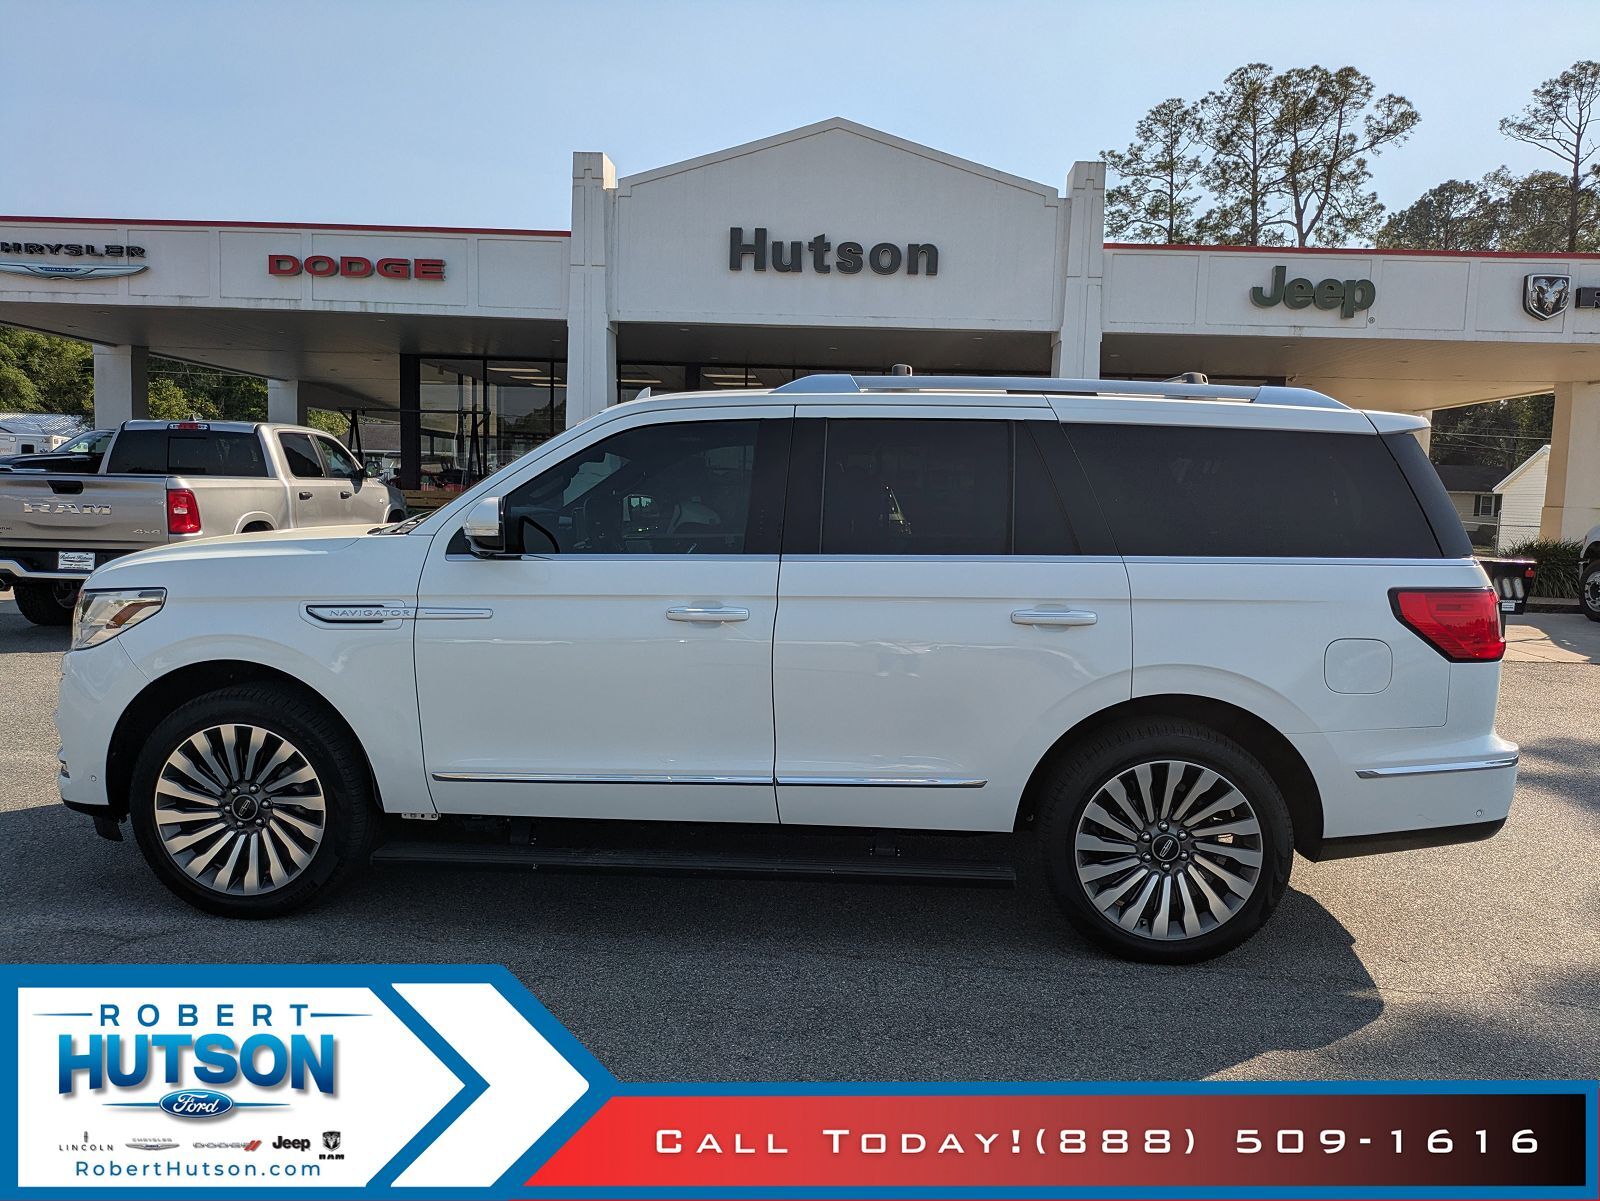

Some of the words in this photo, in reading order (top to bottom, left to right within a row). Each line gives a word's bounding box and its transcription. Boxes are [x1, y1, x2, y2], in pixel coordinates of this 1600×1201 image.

[729, 227, 939, 276] Hutson
[268, 254, 446, 281] DODGE
[1249, 265, 1376, 320] Jeep
[23, 502, 112, 516] RAM
[329, 608, 411, 617] NAVIGATOR
